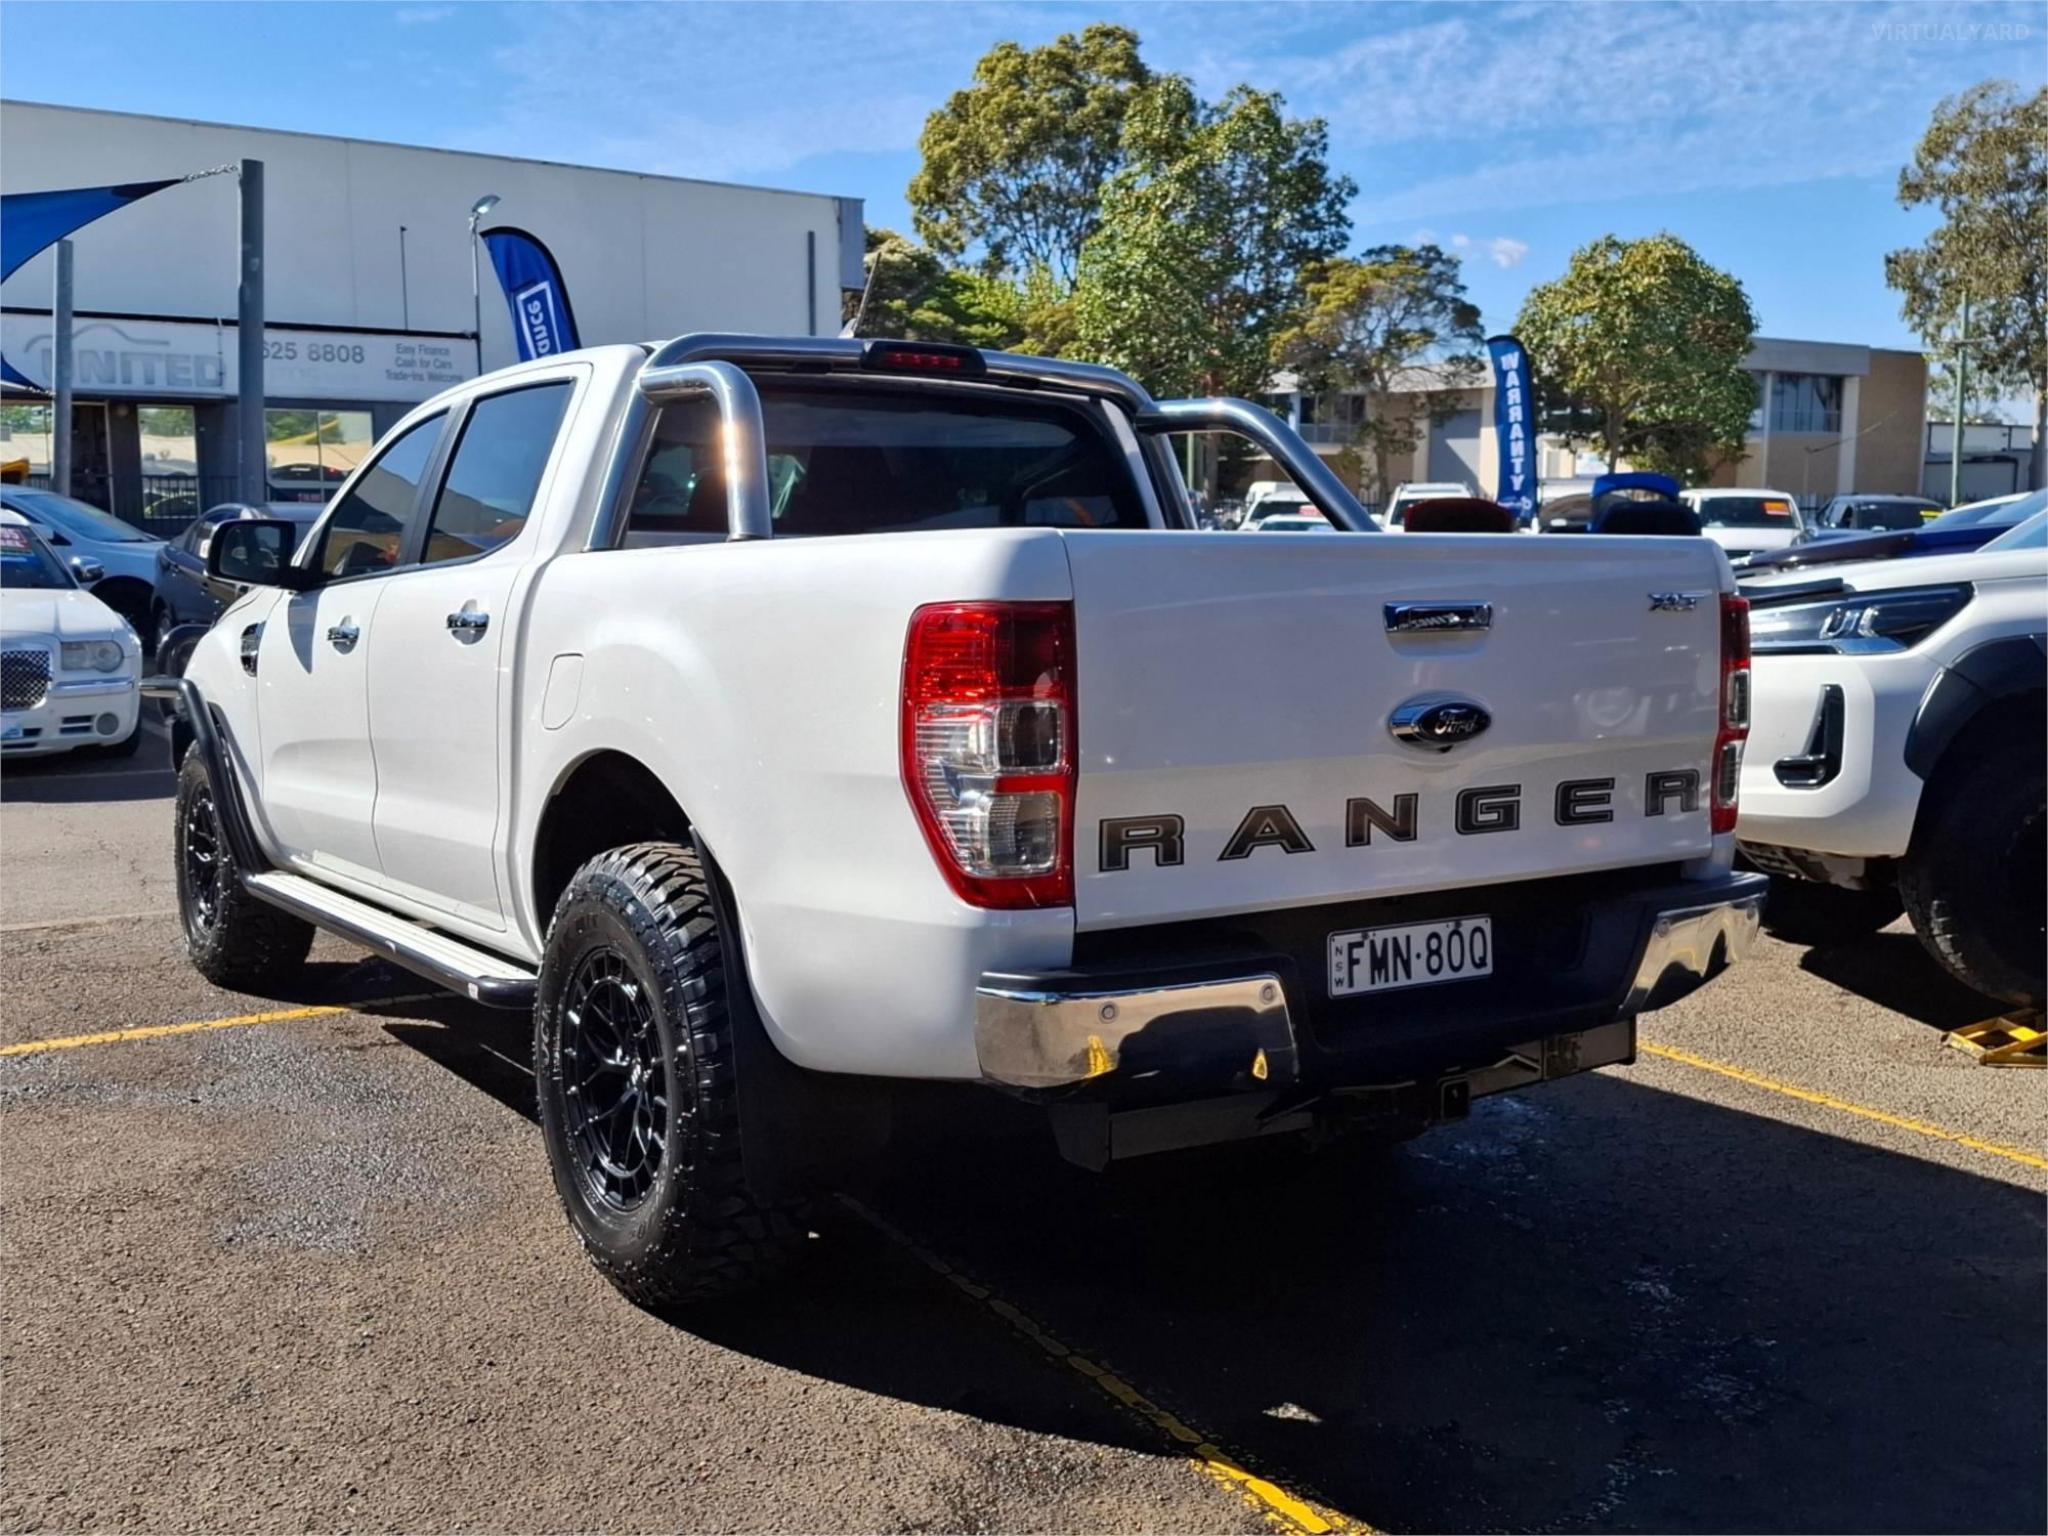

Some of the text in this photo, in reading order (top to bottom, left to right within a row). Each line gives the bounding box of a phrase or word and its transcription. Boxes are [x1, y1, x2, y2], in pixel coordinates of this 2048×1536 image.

[307, 343, 365, 364] 8808
[394, 356, 453, 369] Cash for Cars
[1433, 707, 1479, 735] Ford
[1099, 768, 1700, 872] RANGER
